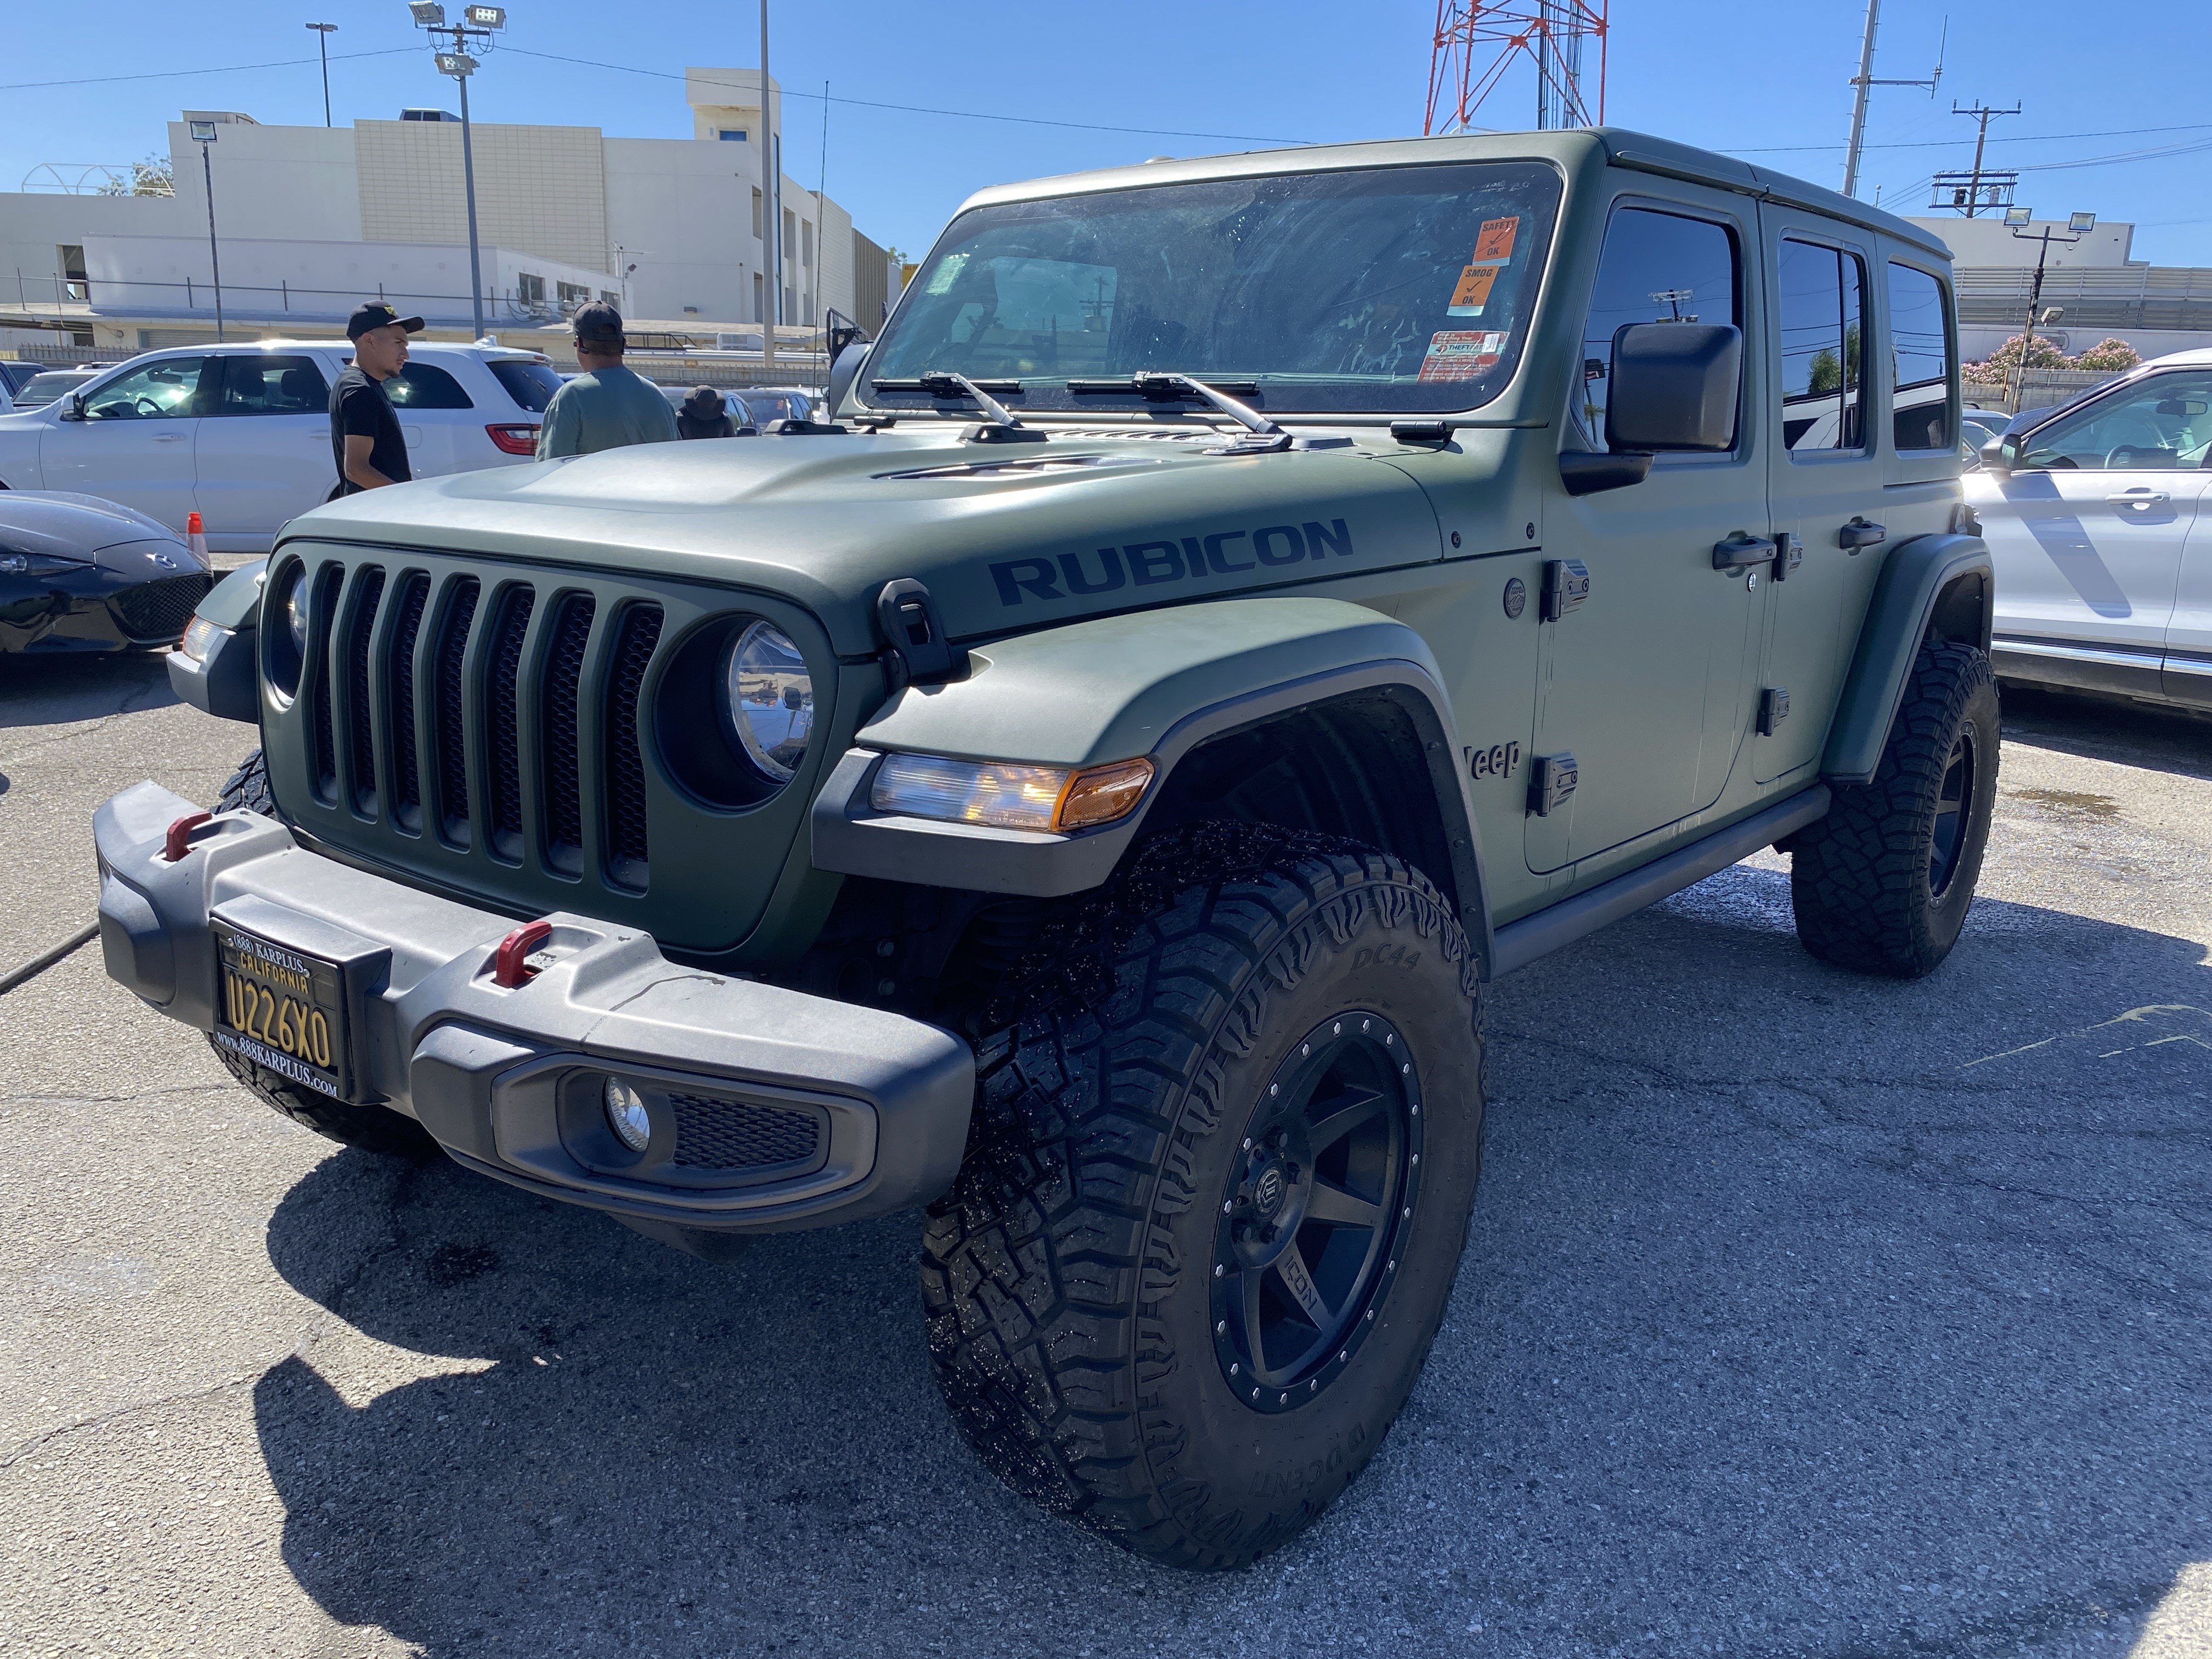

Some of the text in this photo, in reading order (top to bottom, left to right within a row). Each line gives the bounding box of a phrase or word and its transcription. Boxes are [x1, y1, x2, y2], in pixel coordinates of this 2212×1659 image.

[1482, 219, 1517, 232] SAFETY
[1487, 247, 1500, 256] OK
[1465, 269, 1493, 278] SMOG
[1462, 296, 1476, 304] OK
[988, 518, 1353, 607] RUBICON
[233, 933, 304, 973] (888) KARPLUS
[1350, 942, 1422, 973] DC44
[240, 952, 309, 994] CALIFORNIA
[1284, 1255, 1318, 1311] ICON
